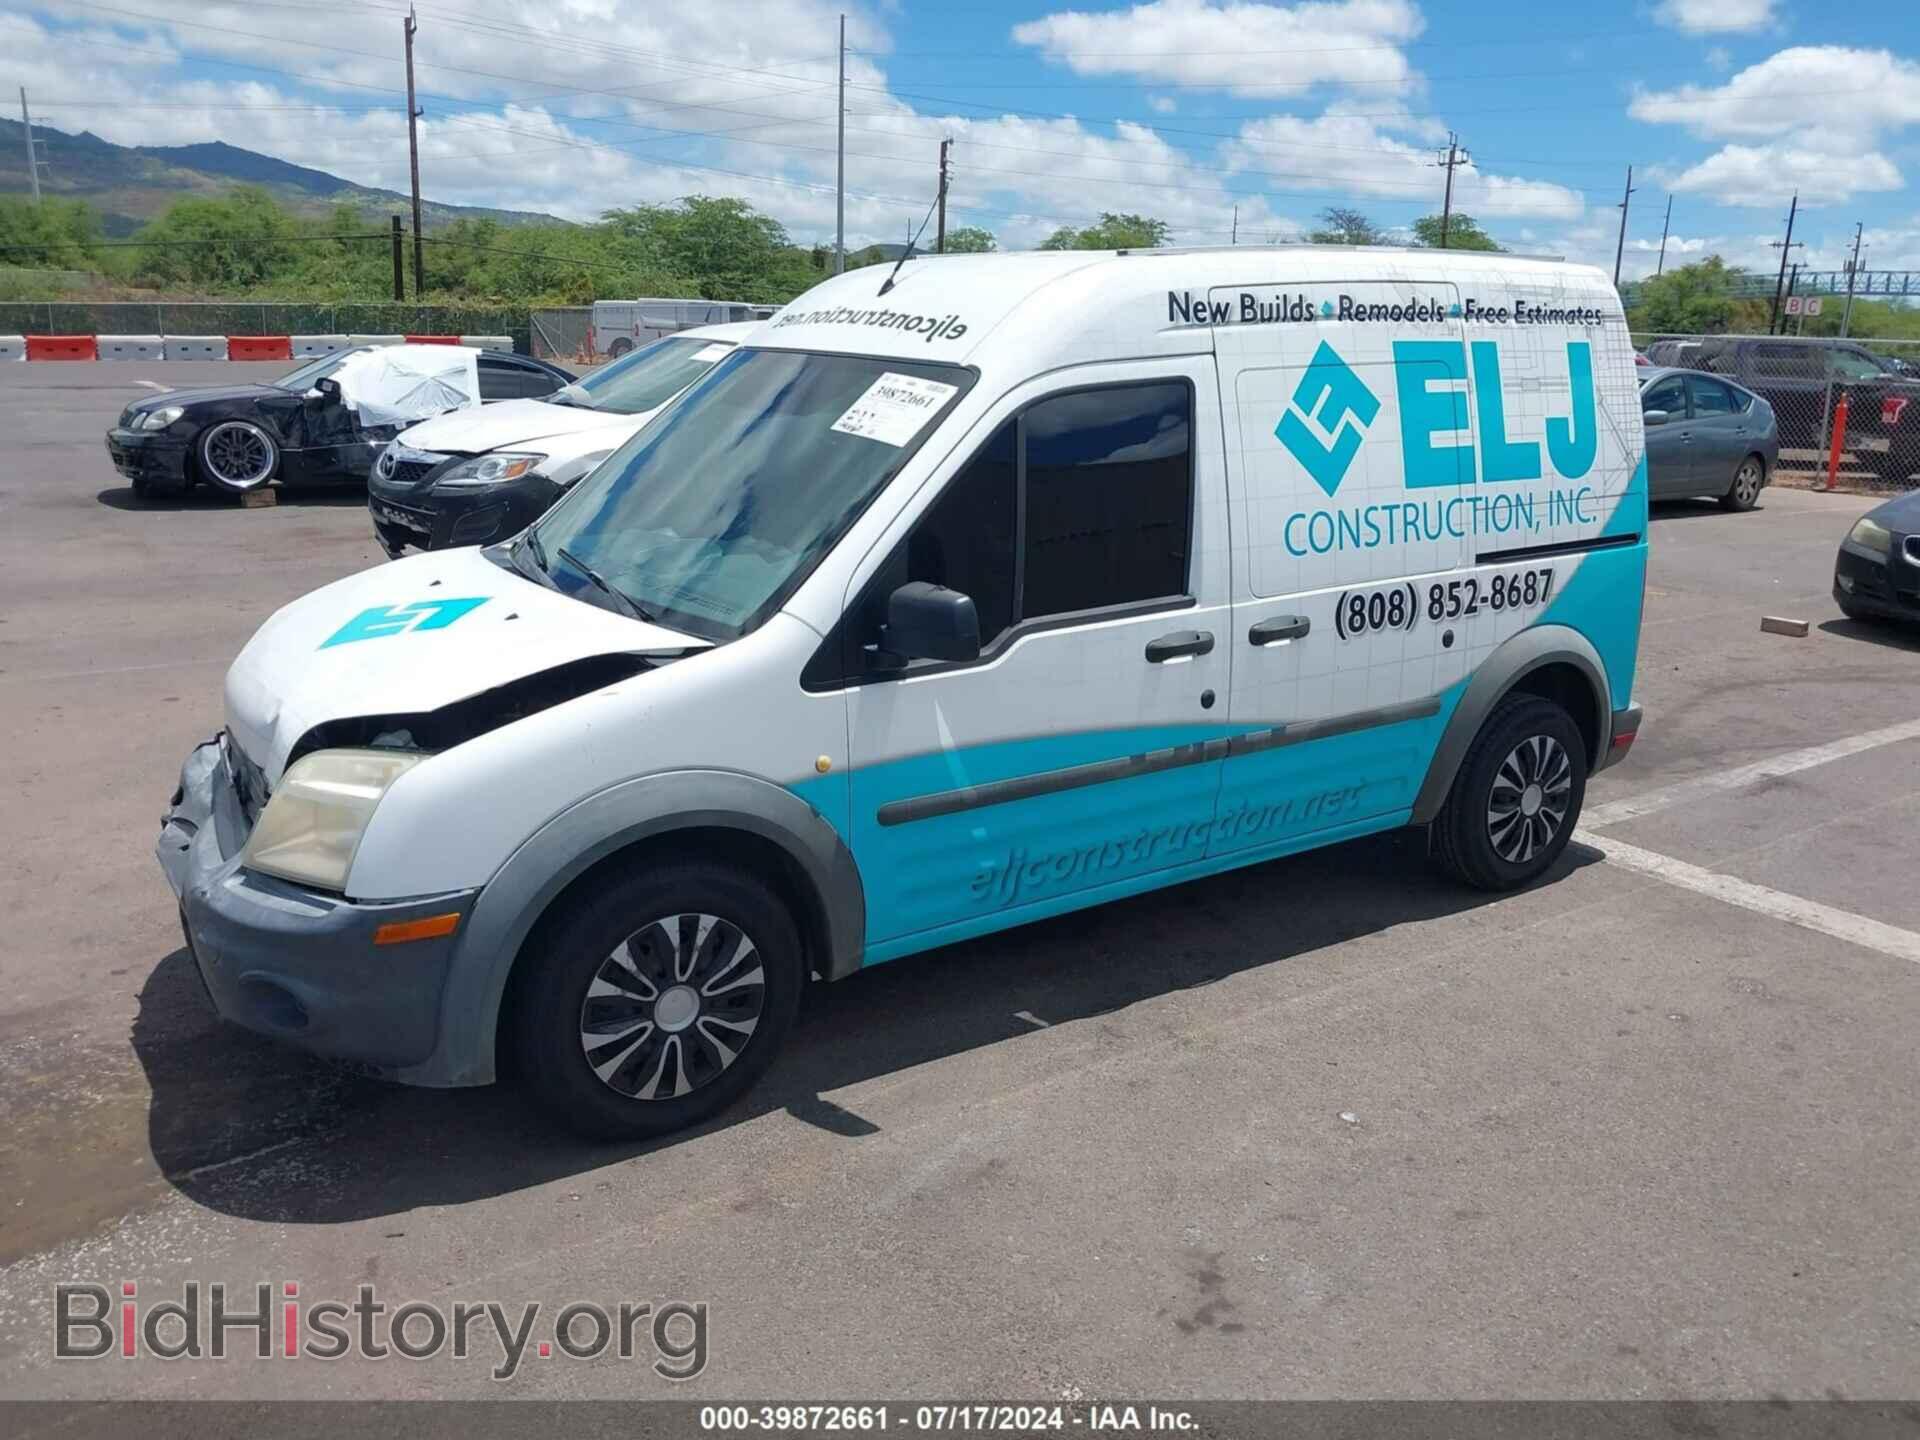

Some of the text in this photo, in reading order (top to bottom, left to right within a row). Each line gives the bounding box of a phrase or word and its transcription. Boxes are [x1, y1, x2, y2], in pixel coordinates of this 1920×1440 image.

[1167, 291, 1603, 326] New Builds Remodels Free Estimates
[1391, 339, 1598, 489] ELJ
[1284, 486, 1597, 556] CONSTRUCTION, INC.
[1335, 568, 1554, 641] (808) 852-8687
